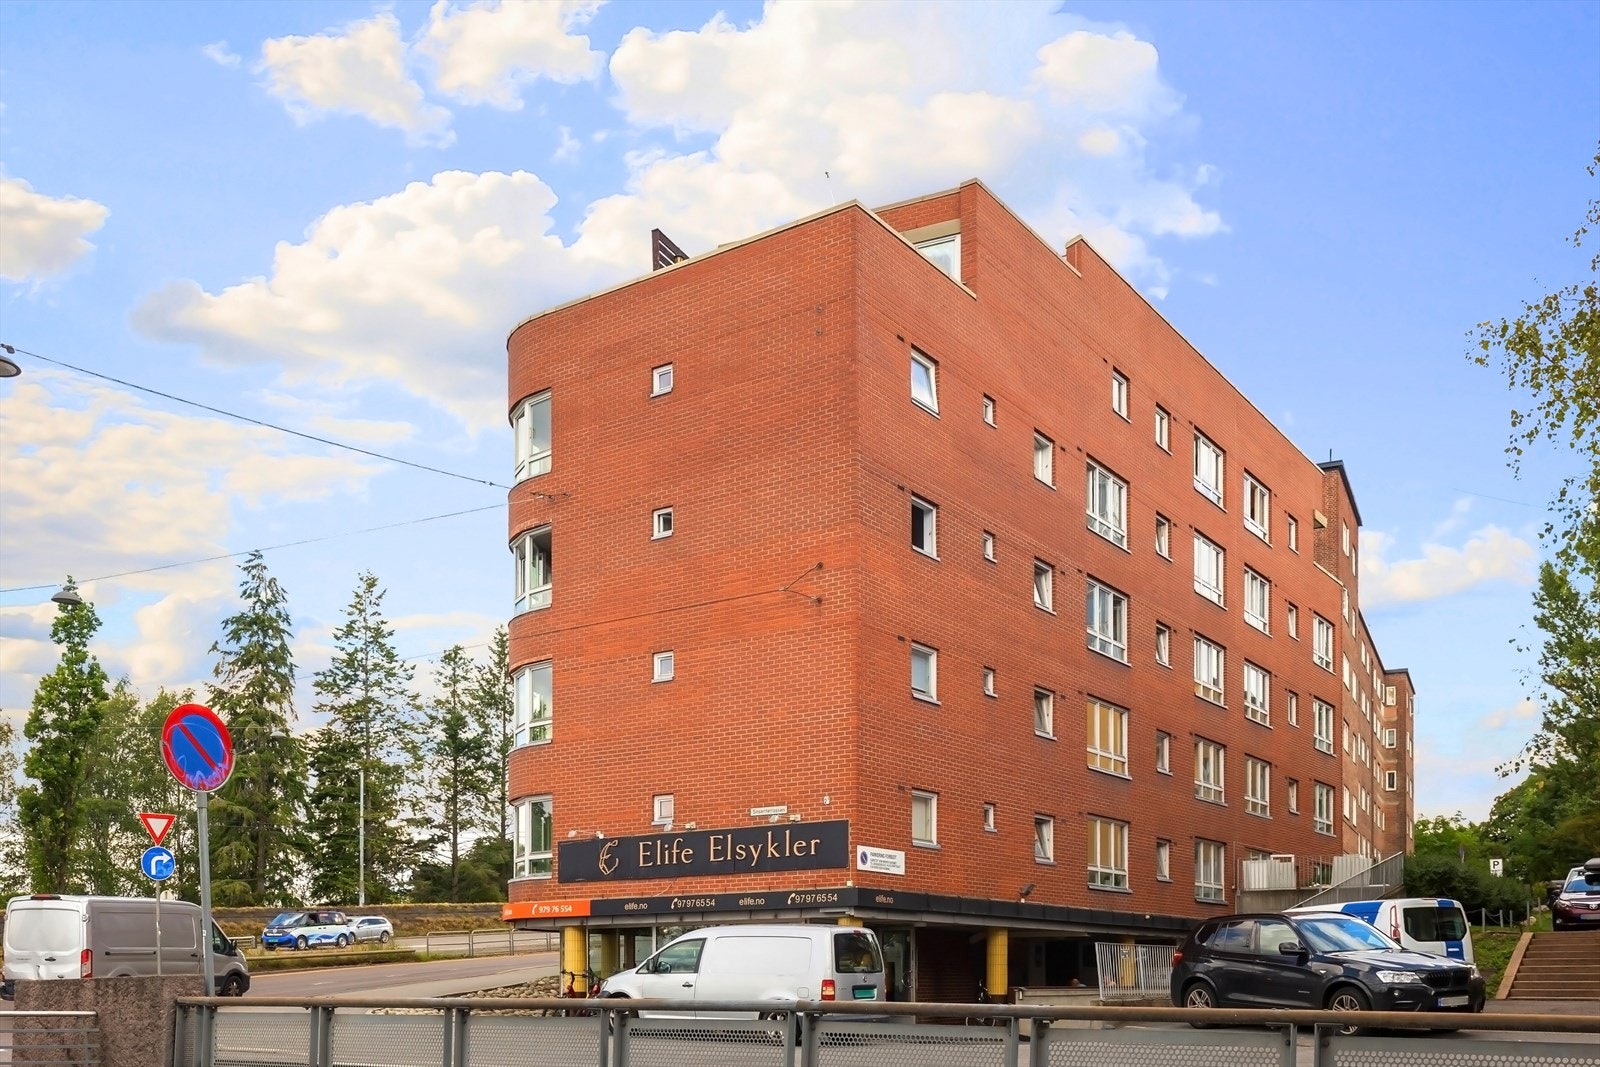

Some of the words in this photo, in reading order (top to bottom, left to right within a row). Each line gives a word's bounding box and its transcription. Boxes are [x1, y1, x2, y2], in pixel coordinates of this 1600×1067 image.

[638, 838, 694, 867] Elife
[709, 829, 821, 866] Elsykler
[1492, 860, 1500, 869] P
[738, 896, 765, 906] elife.no
[875, 894, 894, 904] elife.no
[538, 905, 550, 914] 979
[551, 905, 560, 913] 76
[560, 904, 573, 913] 554
[624, 902, 648, 911] elife.no
